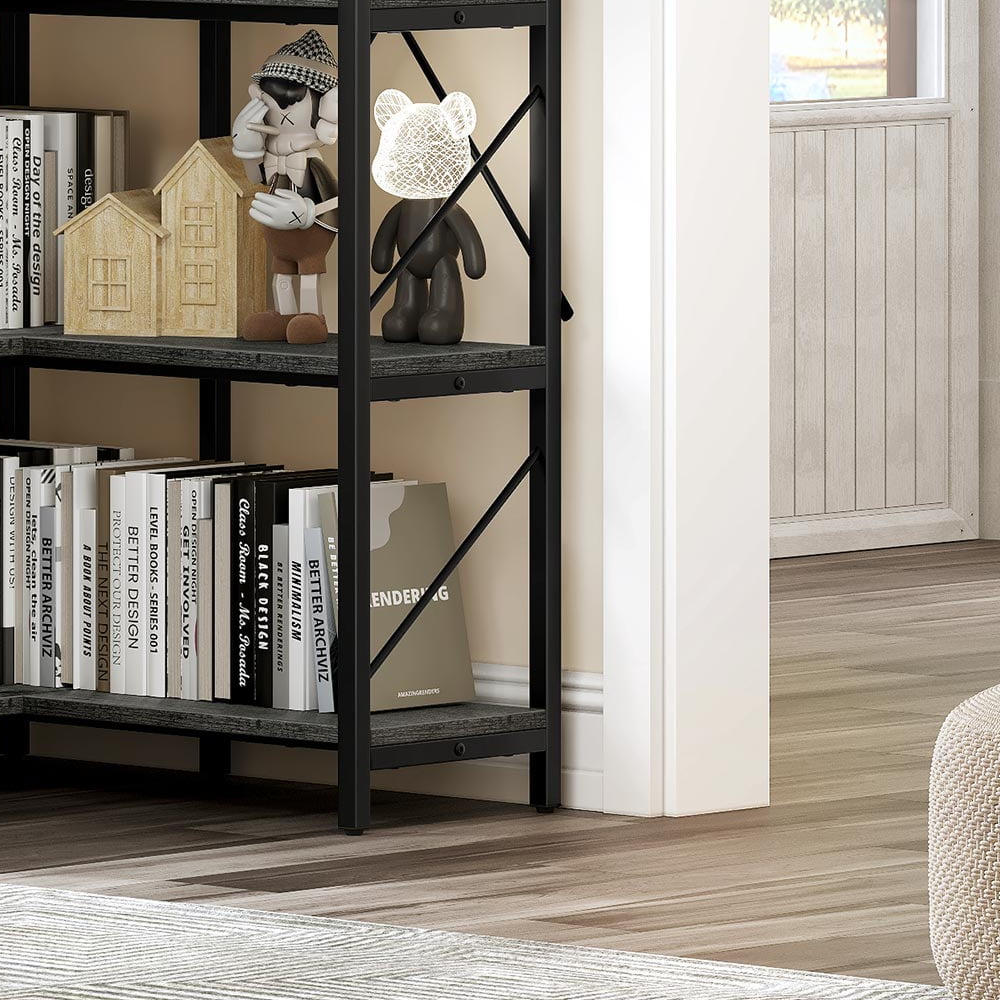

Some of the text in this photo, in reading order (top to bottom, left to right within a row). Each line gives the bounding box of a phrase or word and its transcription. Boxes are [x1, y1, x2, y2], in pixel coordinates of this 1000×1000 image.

[30, 156, 42, 296] Day of the design
[41, 538, 52, 658] BETTER ARCHVIZ
[97, 542, 109, 681] THE NEXT DESIGN
[113, 510, 122, 666] PROTECT OUR DESIGN
[128, 526, 139, 649] BETTER DESIGN
[149, 506, 158, 653] LEVEL BOOKS SERIES 001
[182, 525, 190, 660] GET INVOLVED
[239, 498, 251, 688] Class Room Ms. Posada
[291, 560, 302, 642] MINIMALISM
[308, 559, 330, 682] BETTER ARCHVIZ
